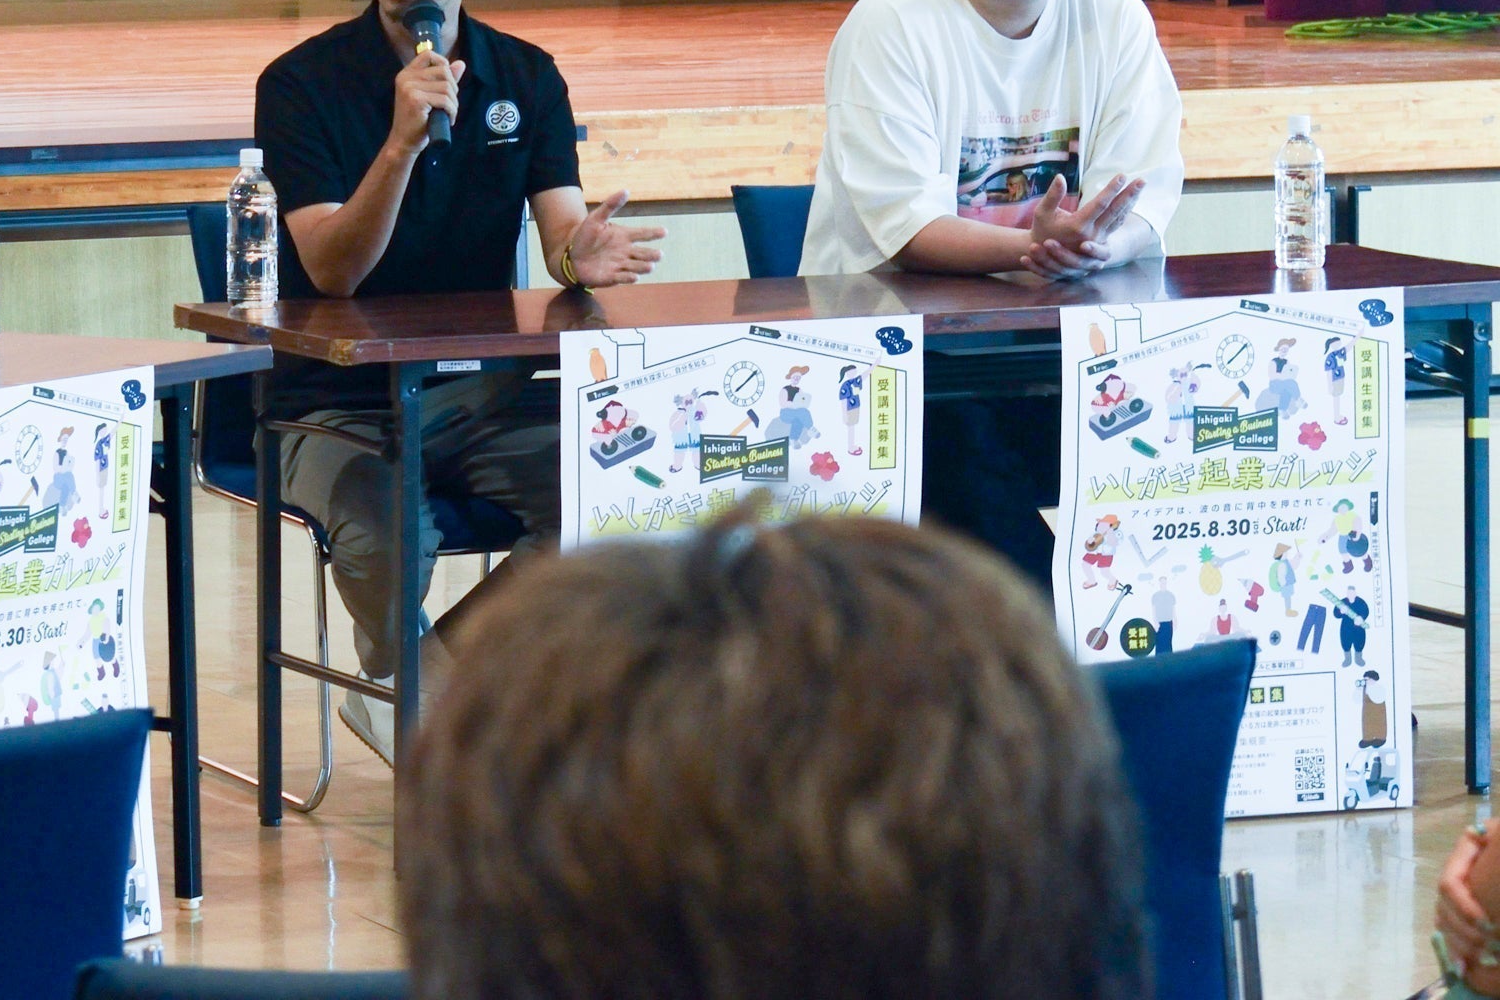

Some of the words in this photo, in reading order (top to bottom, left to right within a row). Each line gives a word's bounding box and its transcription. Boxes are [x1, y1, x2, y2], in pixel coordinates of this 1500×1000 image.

[1361, 349, 1372, 429] 受講生募集
[877, 378, 889, 459] 受講生募集
[1197, 413, 1233, 426] Ishigaki
[703, 442, 741, 455] Ishigaki
[703, 456, 742, 472] Starting
[748, 447, 784, 463] Business
[747, 464, 785, 475] Gallege
[1090, 448, 1378, 501] いしがき起業ガレッジ
[1152, 518, 1251, 541] 2025.8.30
[1263, 515, 1308, 535] Start!
[33, 620, 69, 643] Start!
